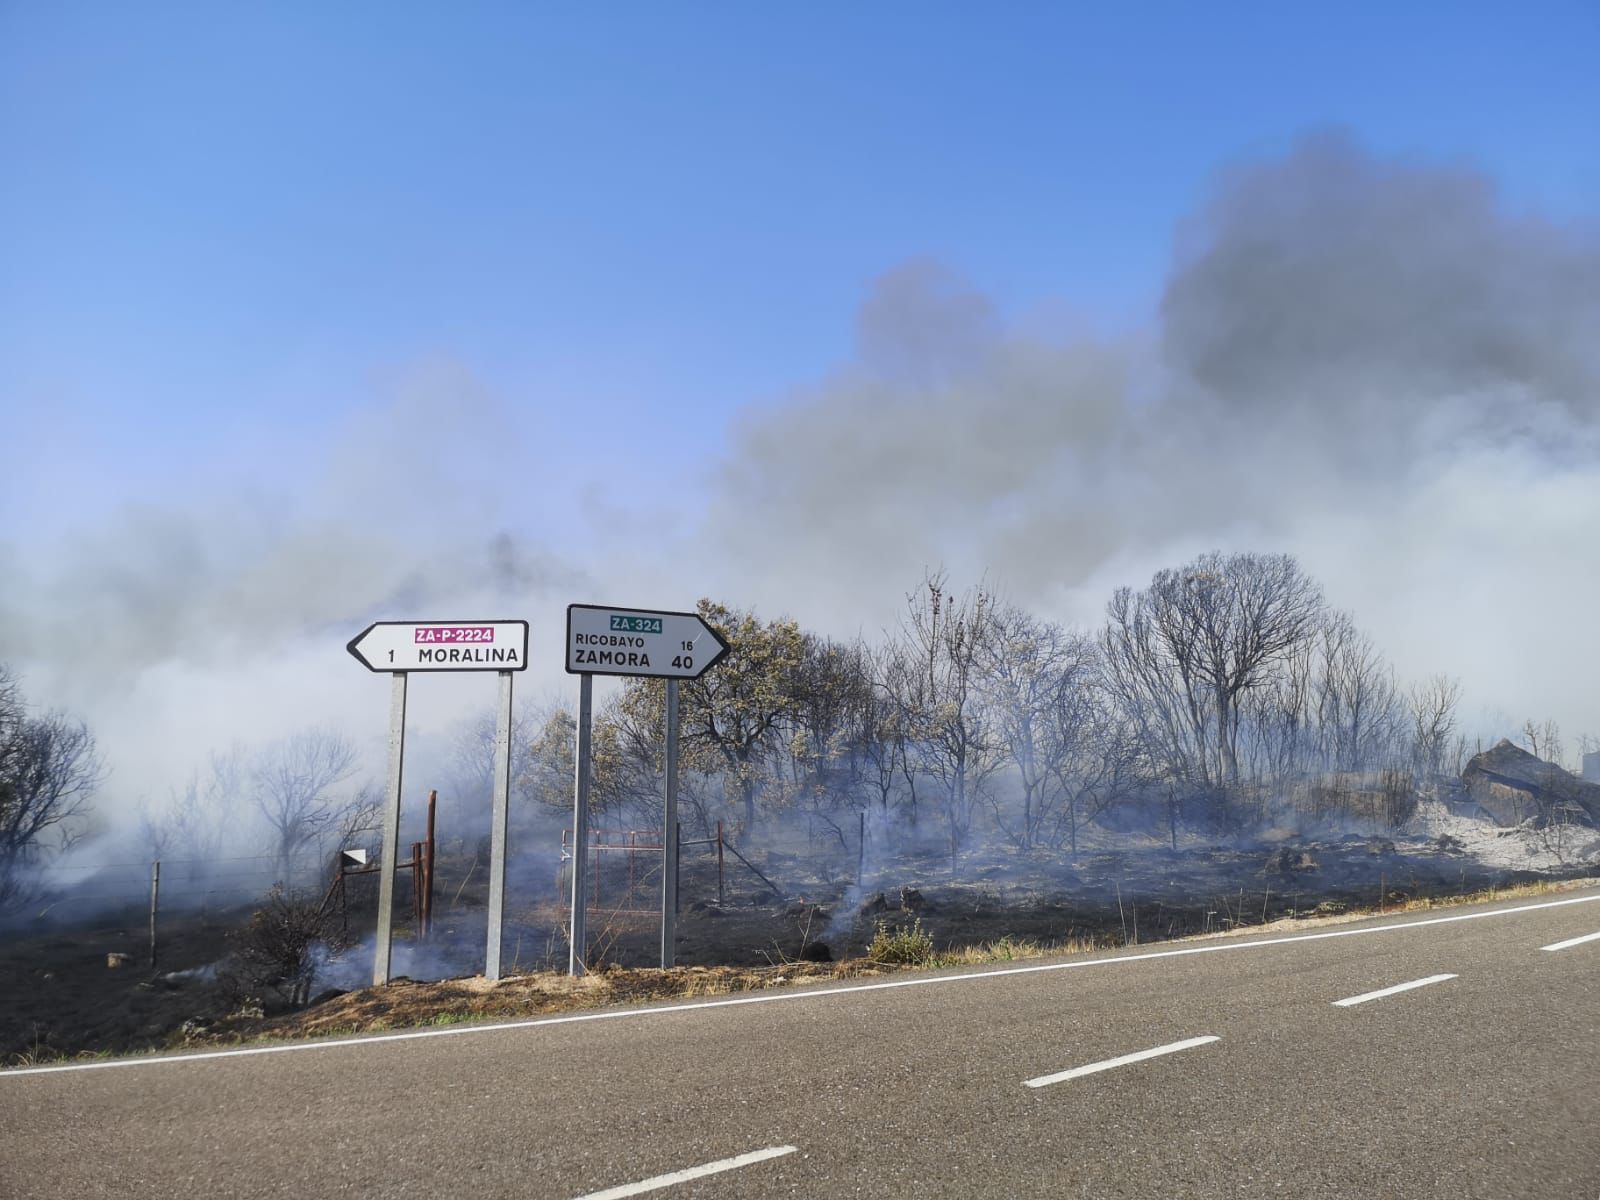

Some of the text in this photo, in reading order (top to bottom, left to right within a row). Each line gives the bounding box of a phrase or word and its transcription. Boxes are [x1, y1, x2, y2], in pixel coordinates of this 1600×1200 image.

[612, 617, 661, 632] ZA-324
[416, 629, 493, 642] ZA-P-2224
[575, 633, 693, 651] RICOBAYO 16
[388, 648, 519, 663] 1 MORALINA
[575, 649, 693, 669] ZAMORA 40
